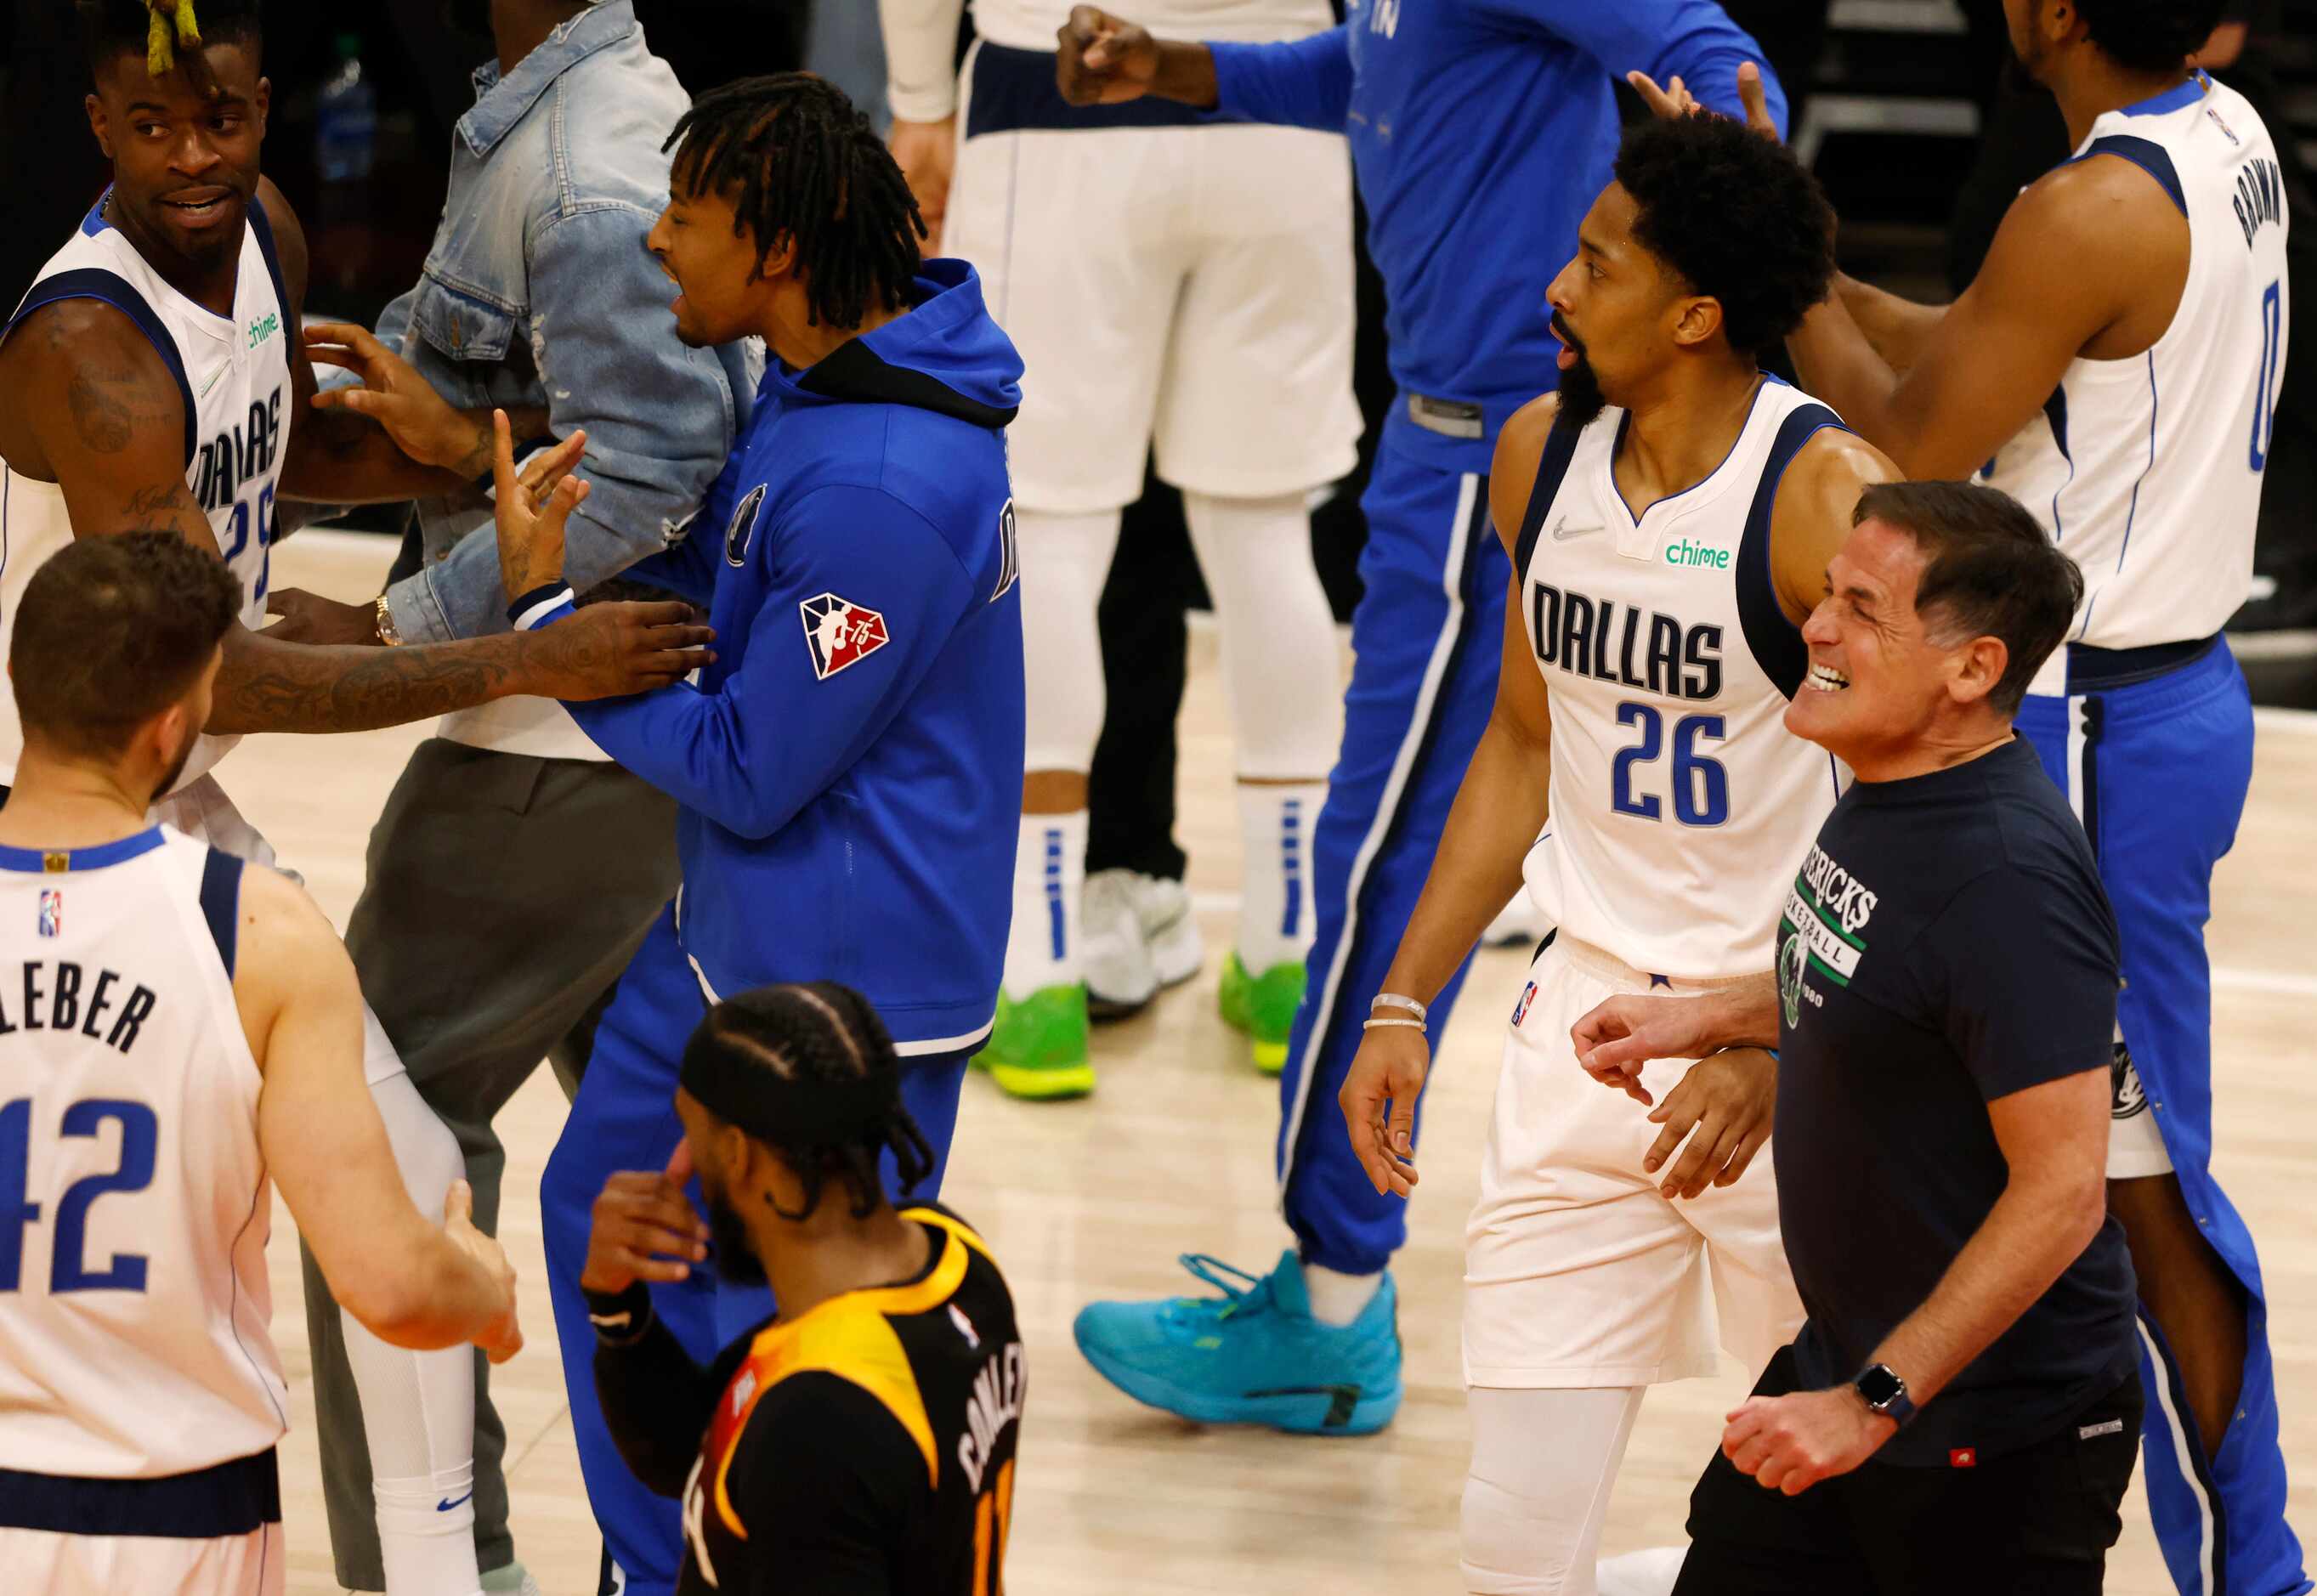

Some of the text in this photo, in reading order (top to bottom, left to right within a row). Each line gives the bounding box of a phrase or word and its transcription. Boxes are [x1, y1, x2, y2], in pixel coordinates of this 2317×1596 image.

[2233, 158, 2280, 252] BROWN
[2250, 276, 2280, 473] 0
[1666, 538, 1730, 569] chime
[850, 620, 874, 646] 75
[1531, 579, 1725, 702] DALLAS
[1611, 700, 1732, 829] 26
[0, 960, 156, 1055] LEBER
